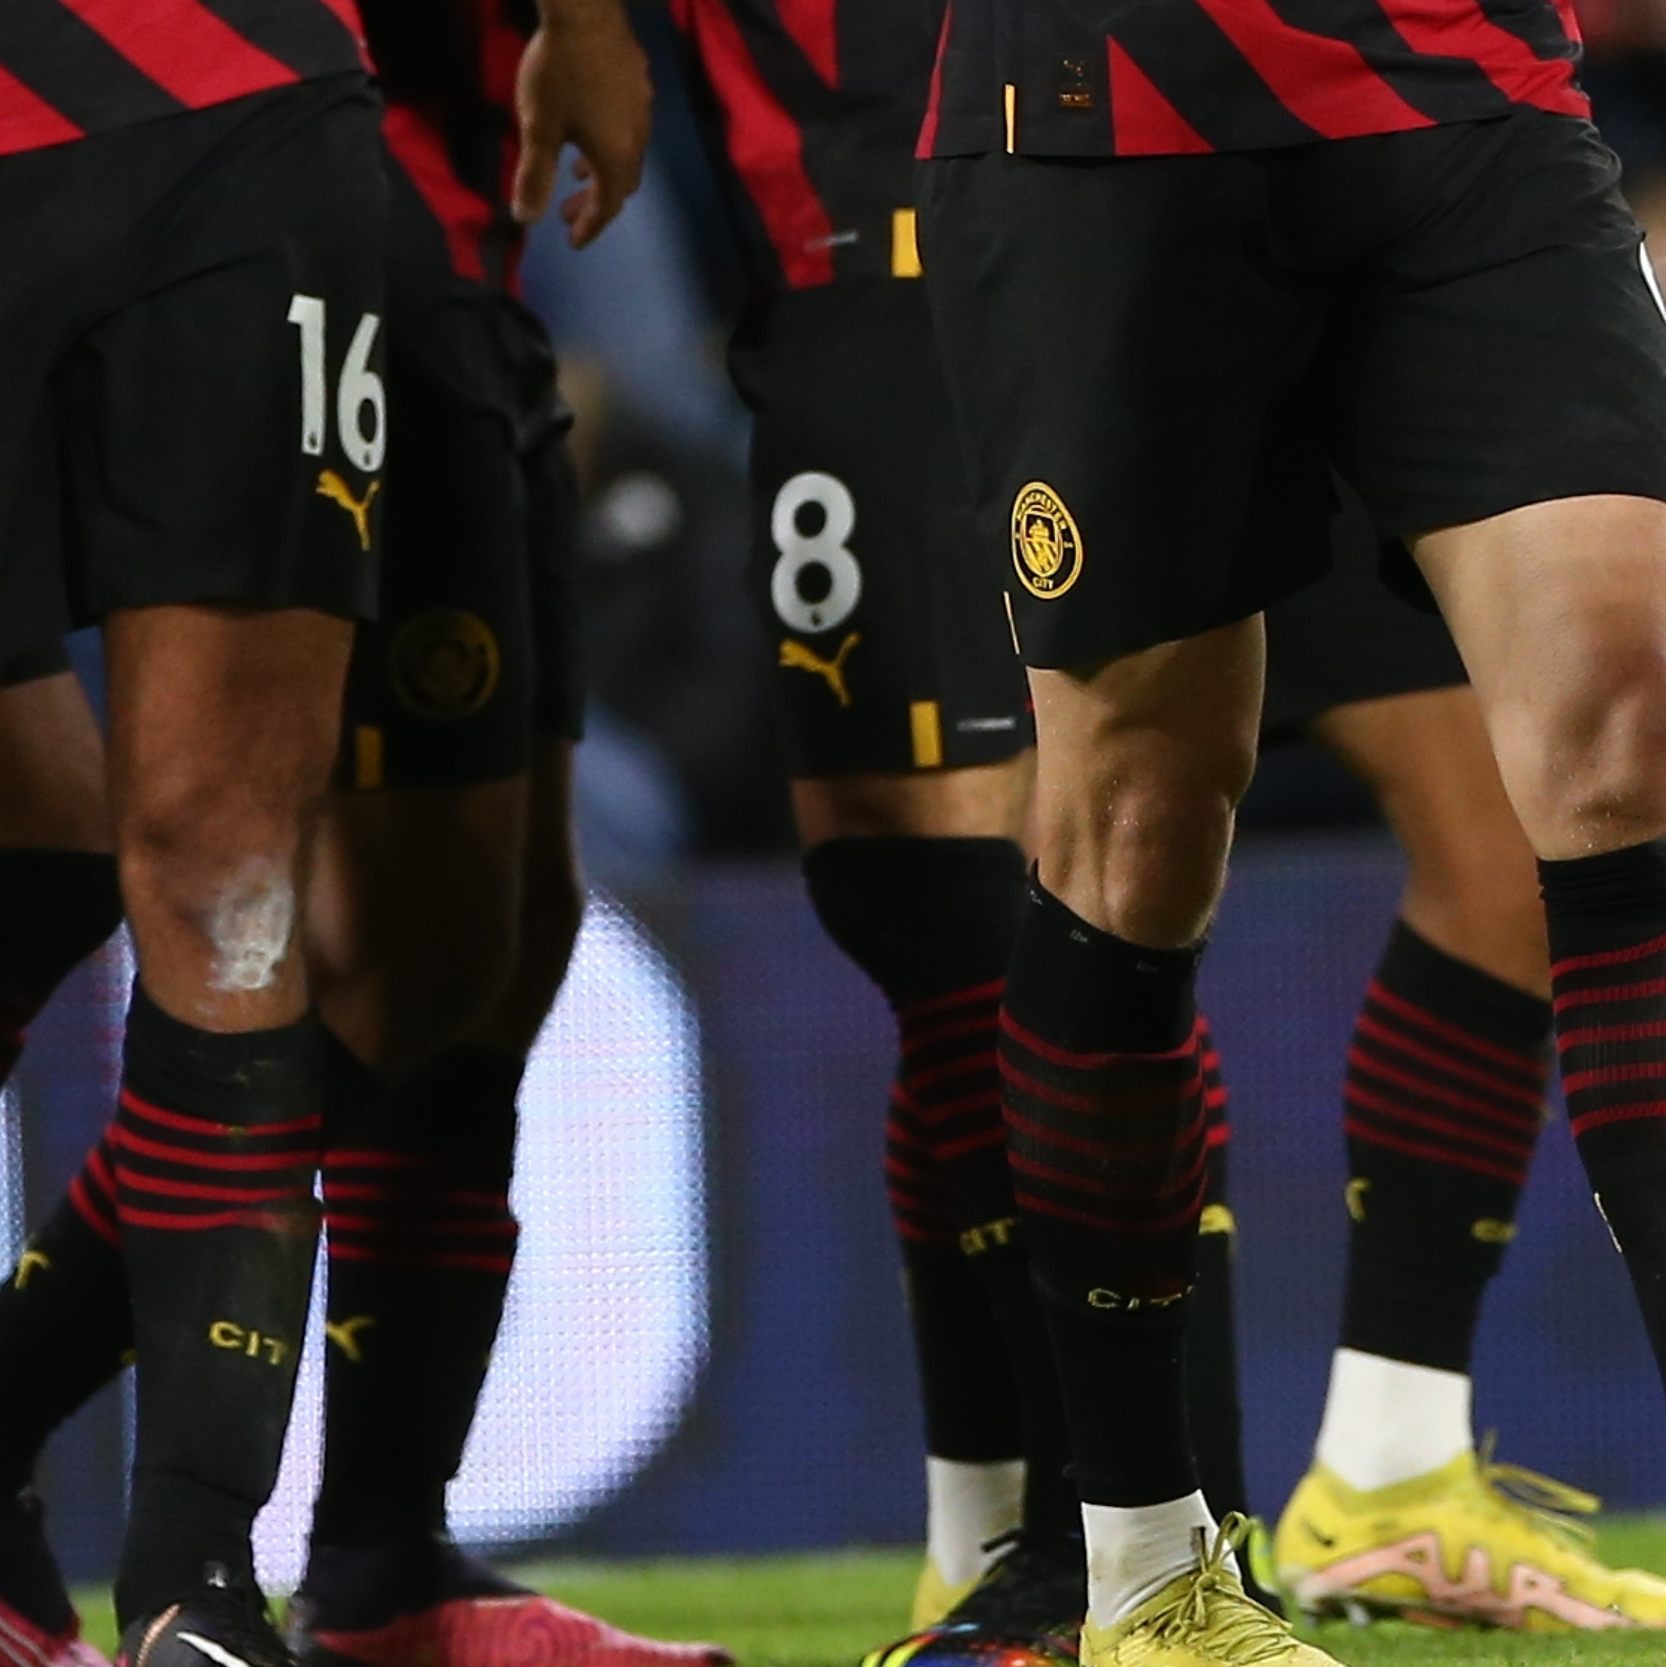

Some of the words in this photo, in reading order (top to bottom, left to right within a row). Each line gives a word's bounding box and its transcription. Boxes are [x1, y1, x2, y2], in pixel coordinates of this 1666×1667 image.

[287, 294, 386, 472] 16
[771, 471, 862, 633] 8
[210, 1321, 283, 1365] CIT
